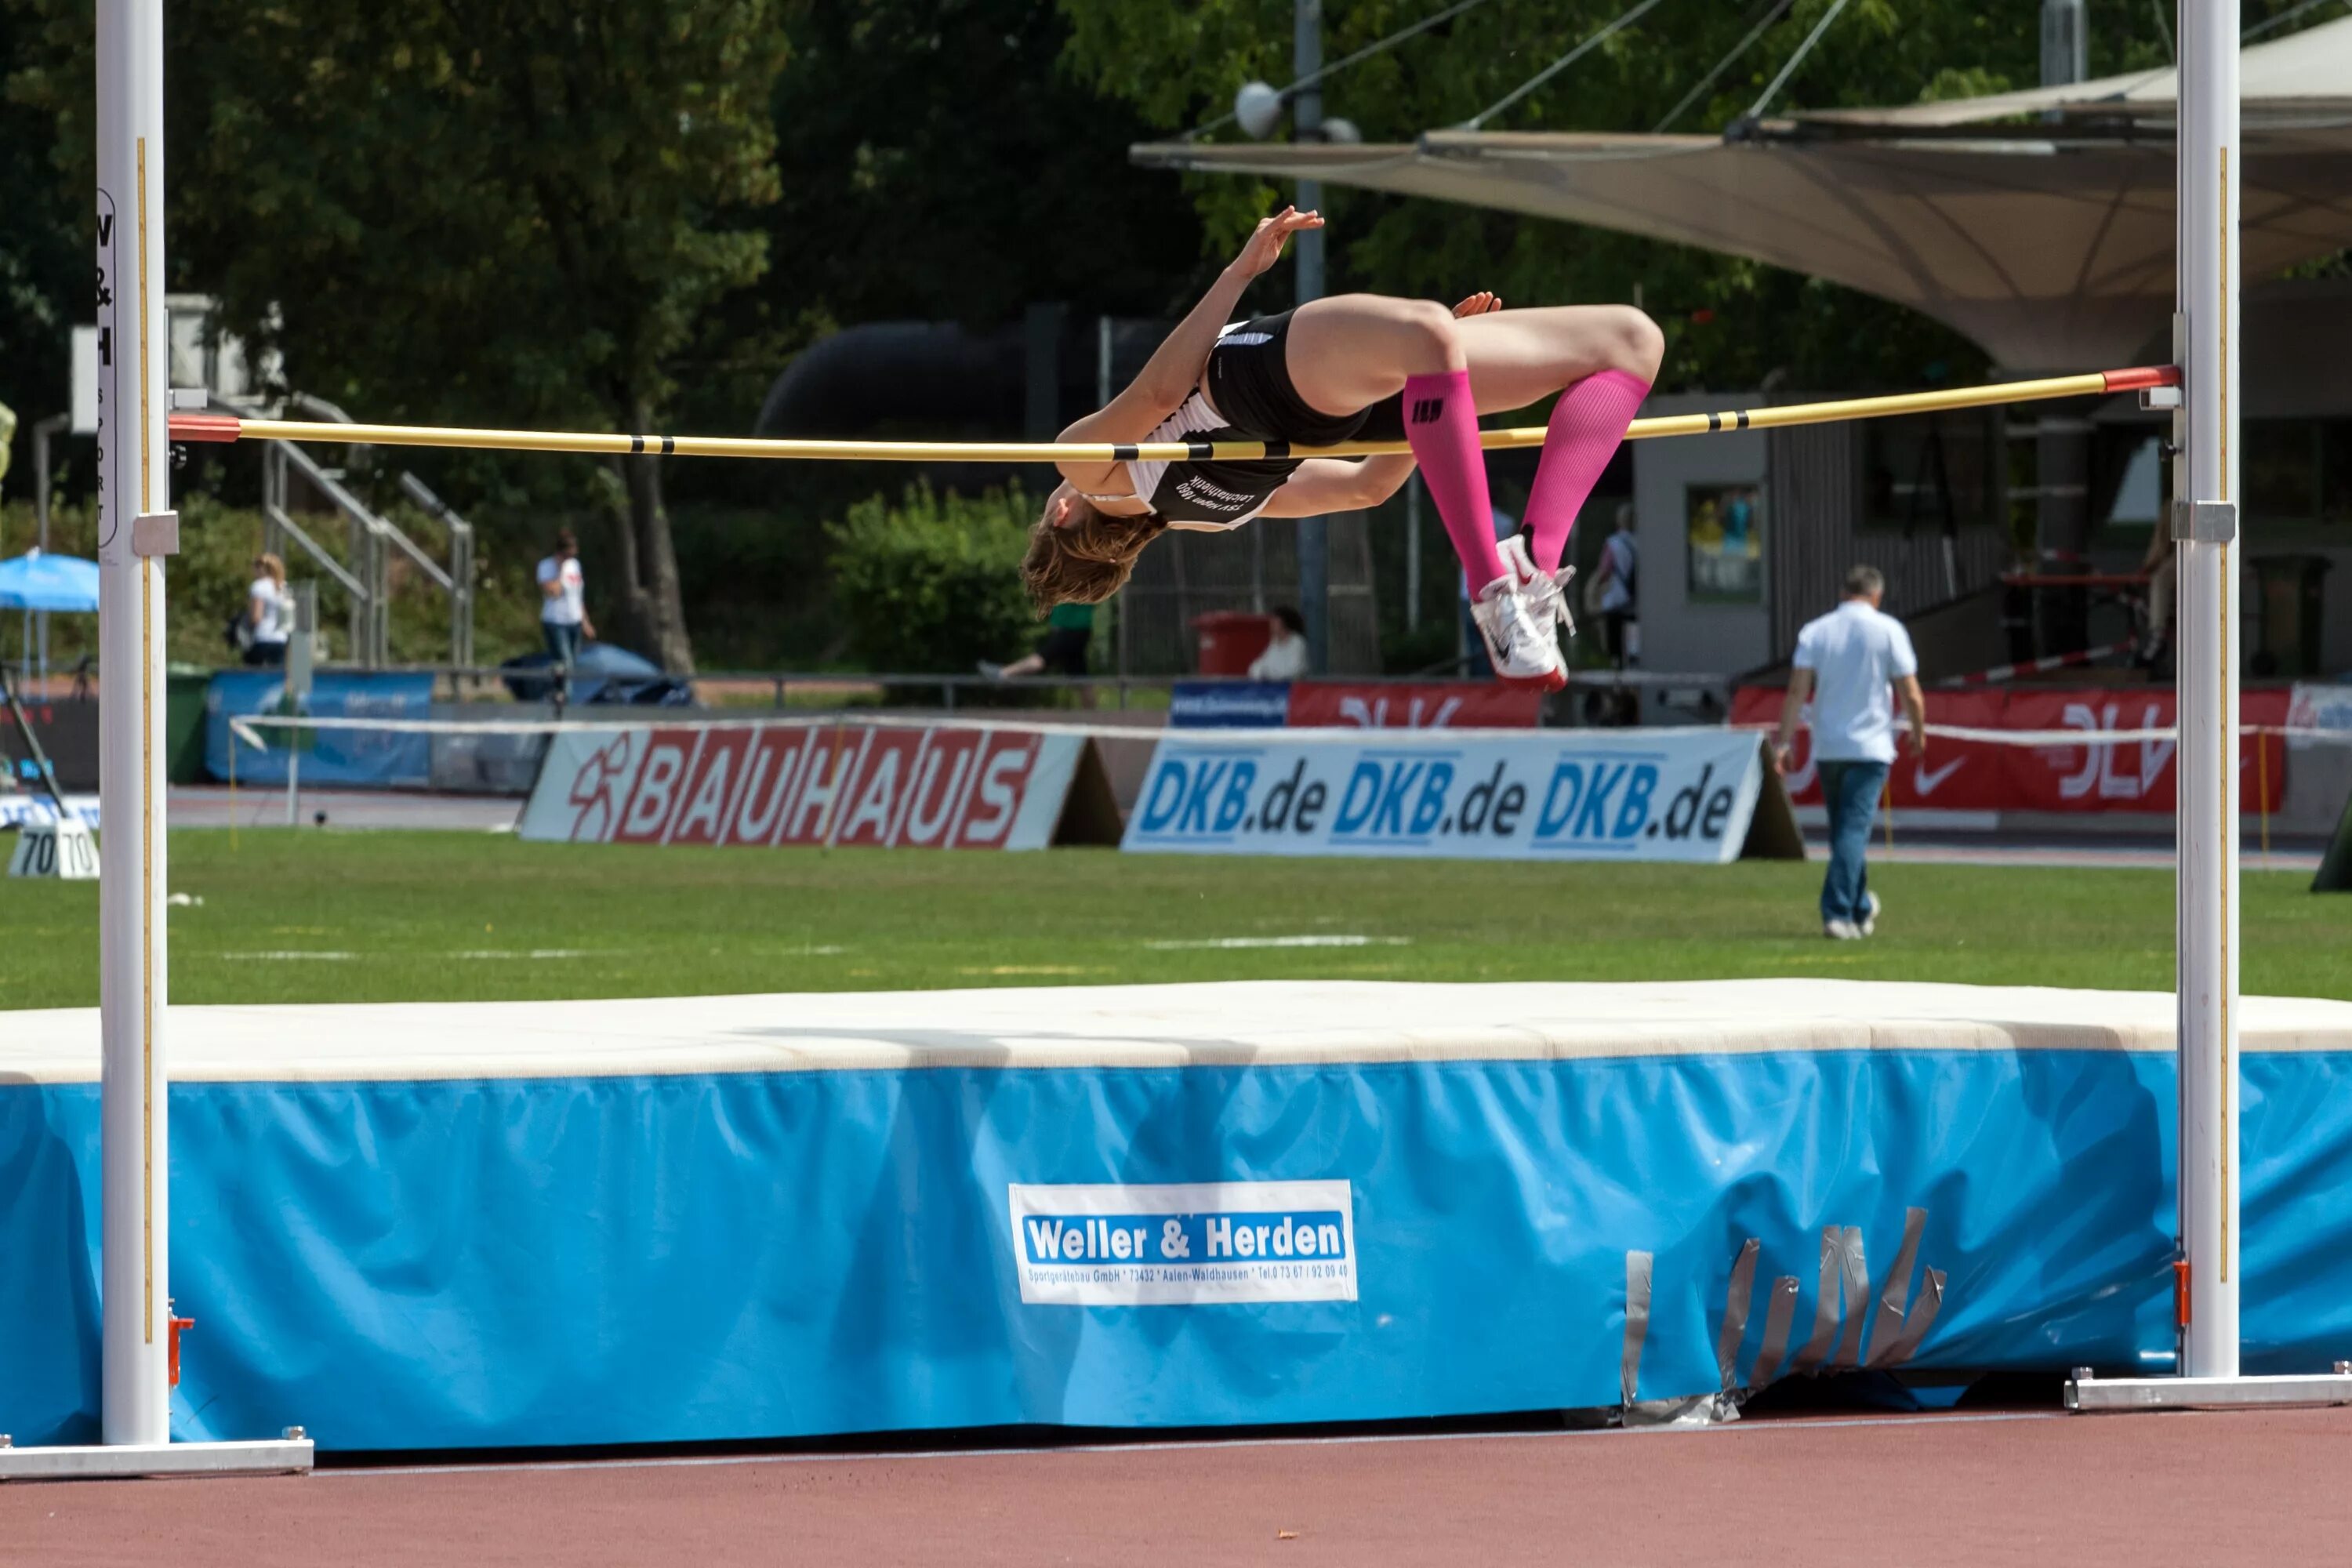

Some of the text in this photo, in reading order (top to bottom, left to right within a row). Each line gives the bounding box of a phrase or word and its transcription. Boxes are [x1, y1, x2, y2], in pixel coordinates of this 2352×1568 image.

[1176, 482, 1196, 500] 1860
[1189, 474, 1254, 503] Leichtathletik
[622, 745, 1027, 844] BAUHAUS
[1139, 757, 1733, 840] DKB.de DKB.de DKB.de
[21, 832, 56, 876] 70
[62, 833, 93, 873] 70
[1028, 1216, 1341, 1259] Weller & Herden
[1094, 1269, 1120, 1283] GmbH
[1130, 1269, 1154, 1282] 73432
[1163, 1267, 1248, 1282] Aalen-Waldhausen
[1280, 1265, 1290, 1279] 73
